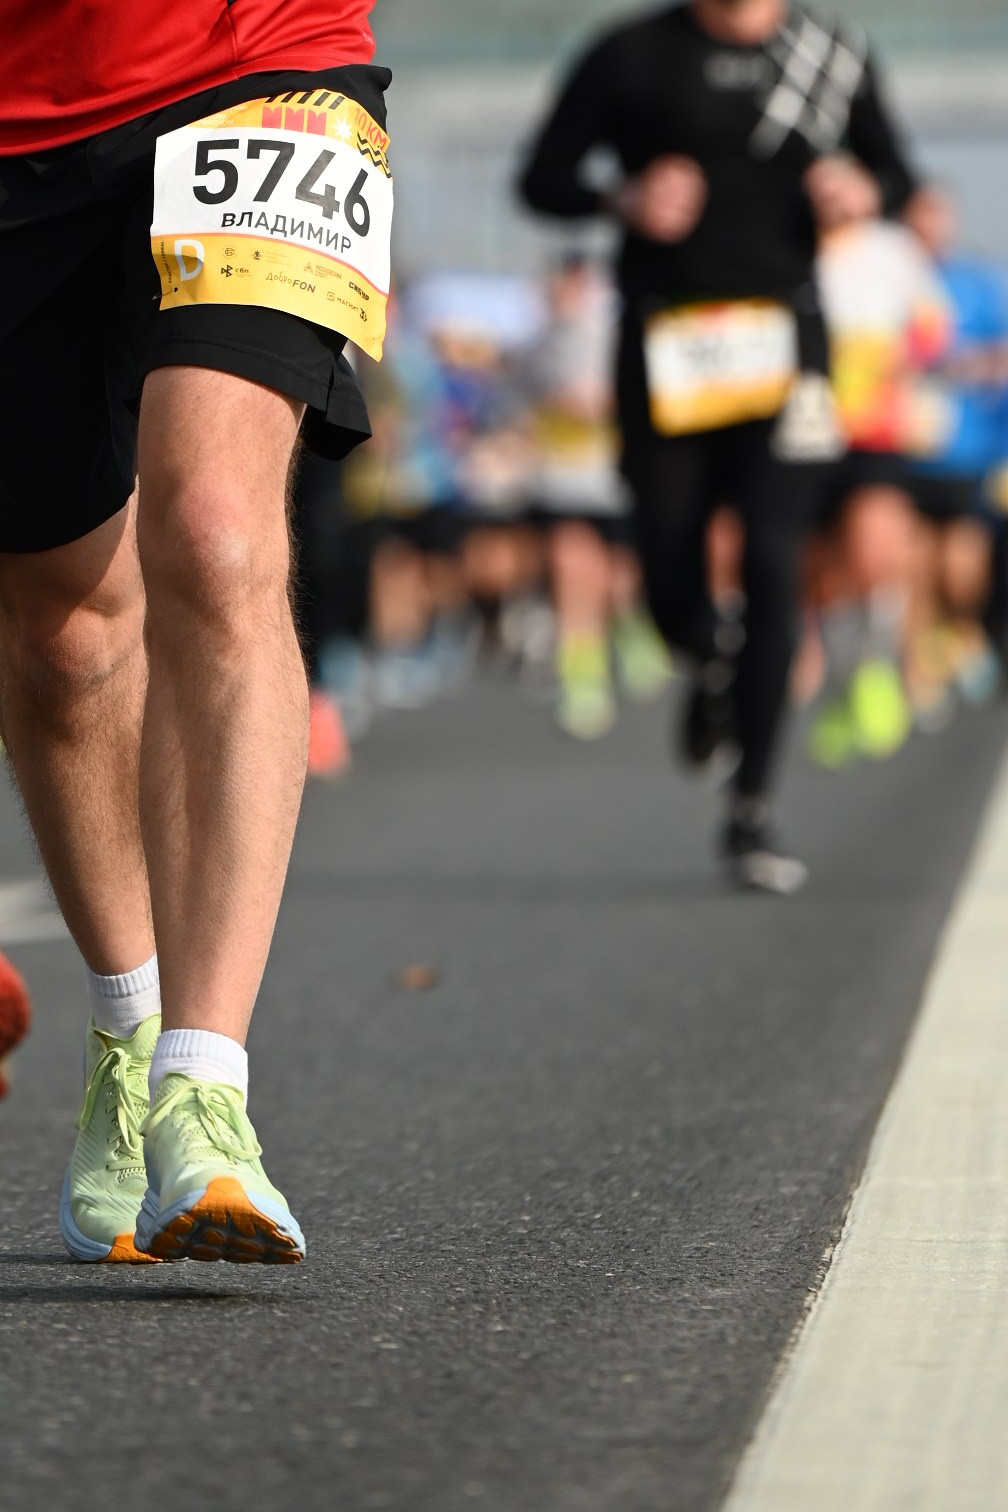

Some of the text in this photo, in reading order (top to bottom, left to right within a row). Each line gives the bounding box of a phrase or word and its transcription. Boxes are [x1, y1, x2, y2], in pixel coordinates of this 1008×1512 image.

[354, 108, 367, 132] 10
[192, 138, 371, 238] 5746
[221, 211, 352, 254] ВЛАДИМИР
[173, 239, 205, 282] D
